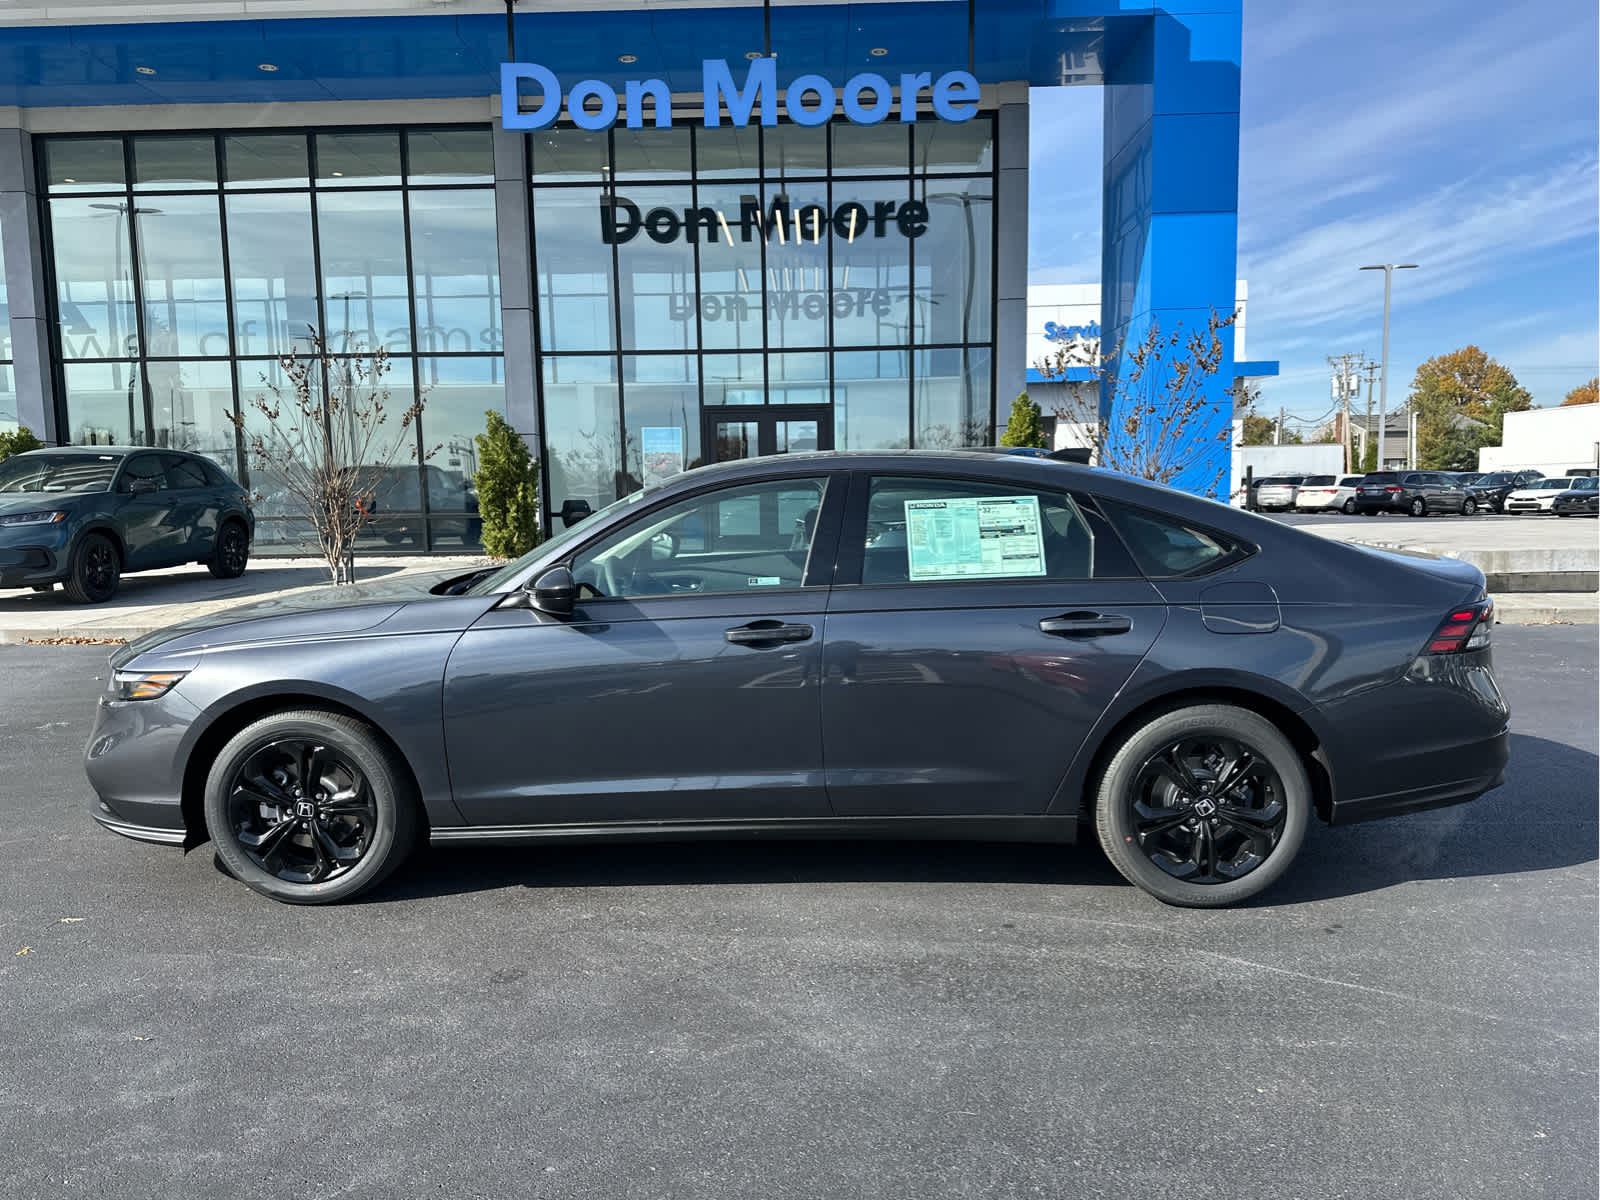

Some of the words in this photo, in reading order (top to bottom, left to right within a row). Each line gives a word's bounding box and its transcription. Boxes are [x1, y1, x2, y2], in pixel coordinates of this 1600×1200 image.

[500, 61, 673, 133] Don
[702, 56, 981, 128] Moore
[599, 194, 719, 244] Don
[739, 193, 930, 243] Moore
